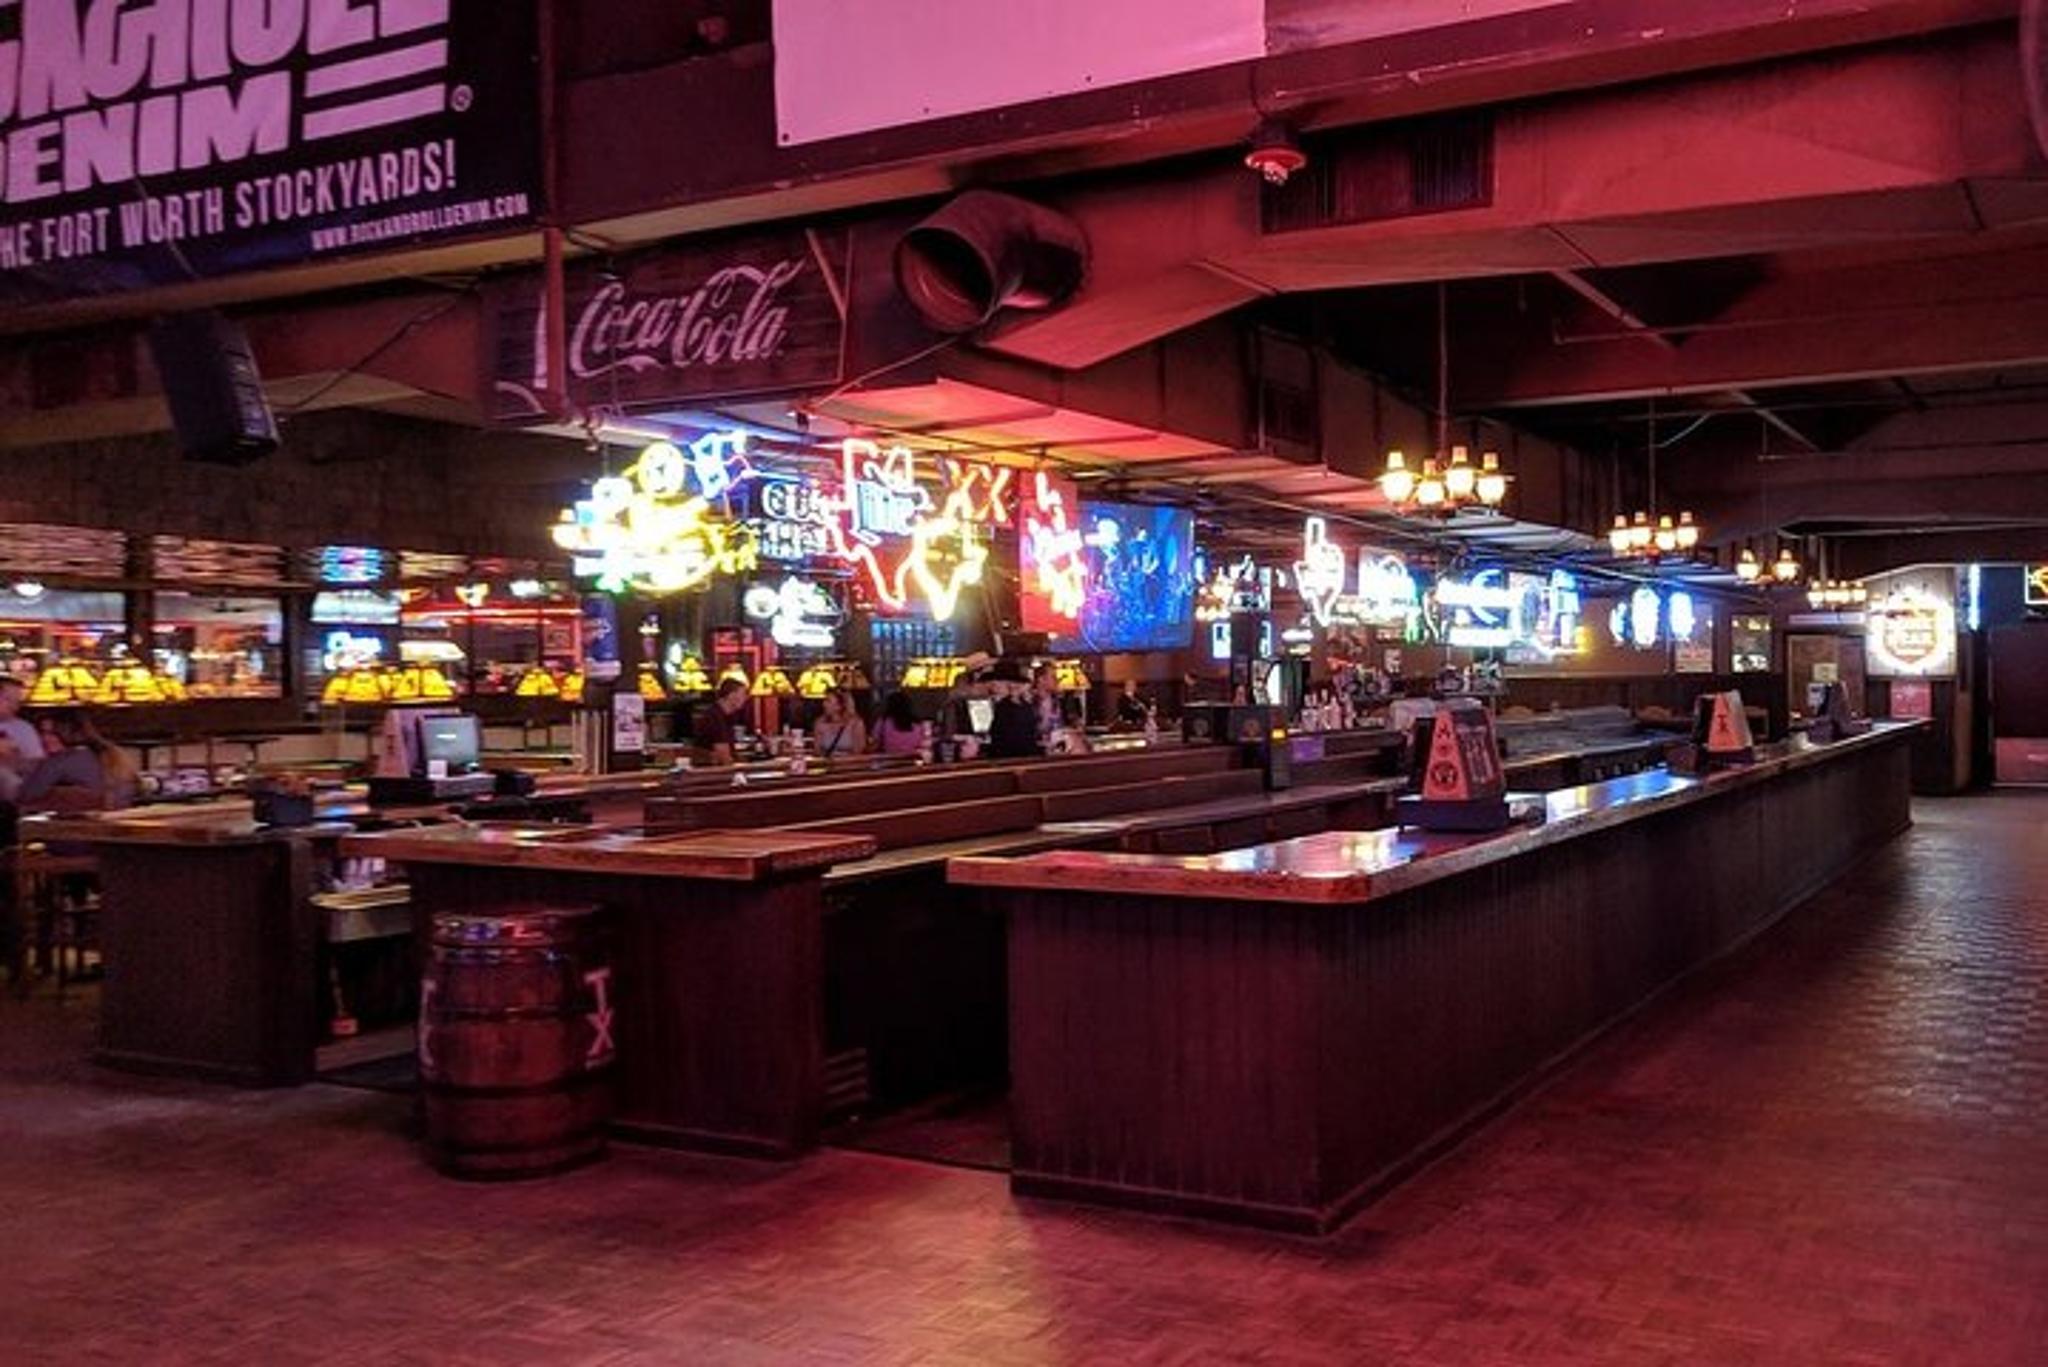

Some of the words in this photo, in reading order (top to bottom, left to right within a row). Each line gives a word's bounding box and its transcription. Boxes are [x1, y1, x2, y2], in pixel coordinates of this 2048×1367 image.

[0, 70, 290, 203] ENIM
[42, 207, 110, 261] FORT
[119, 187, 223, 248] WORTH
[235, 139, 456, 229] STOCKYARDS!
